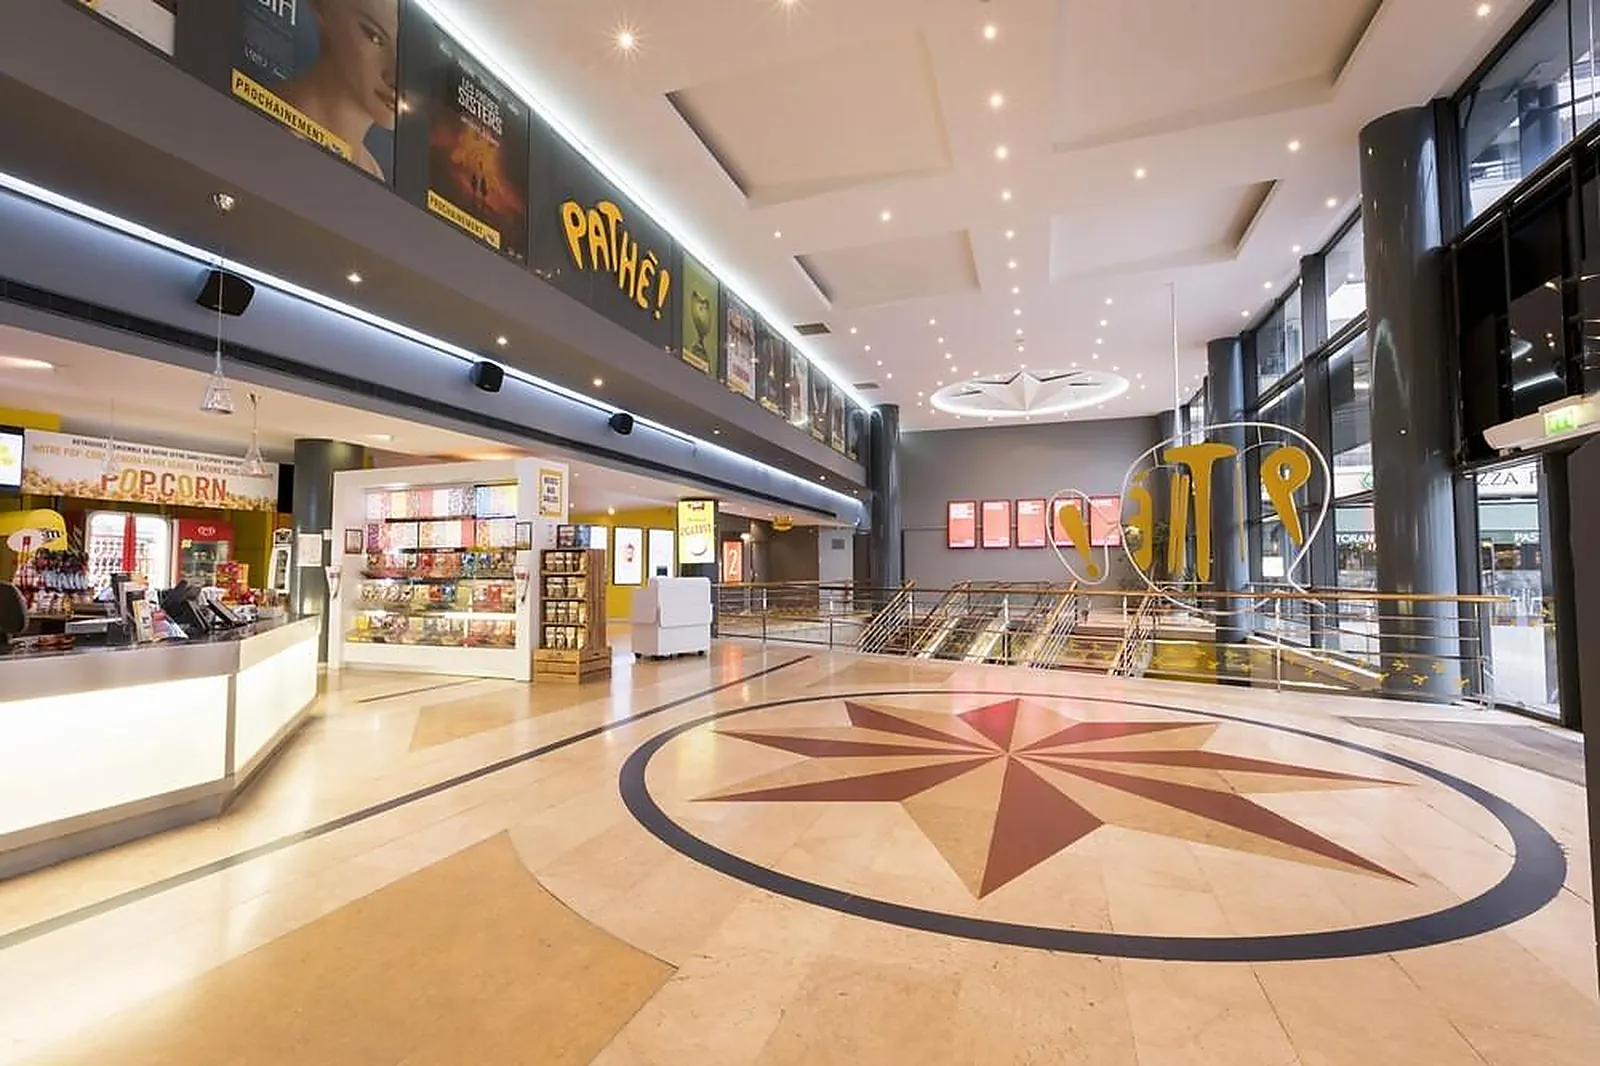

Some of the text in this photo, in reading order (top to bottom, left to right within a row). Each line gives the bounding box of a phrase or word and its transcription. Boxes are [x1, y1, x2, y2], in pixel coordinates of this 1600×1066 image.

[234, 77, 325, 144] PROCHAINEMENT
[458, 85, 503, 136] SISTERS
[728, 548, 738, 577] 2
